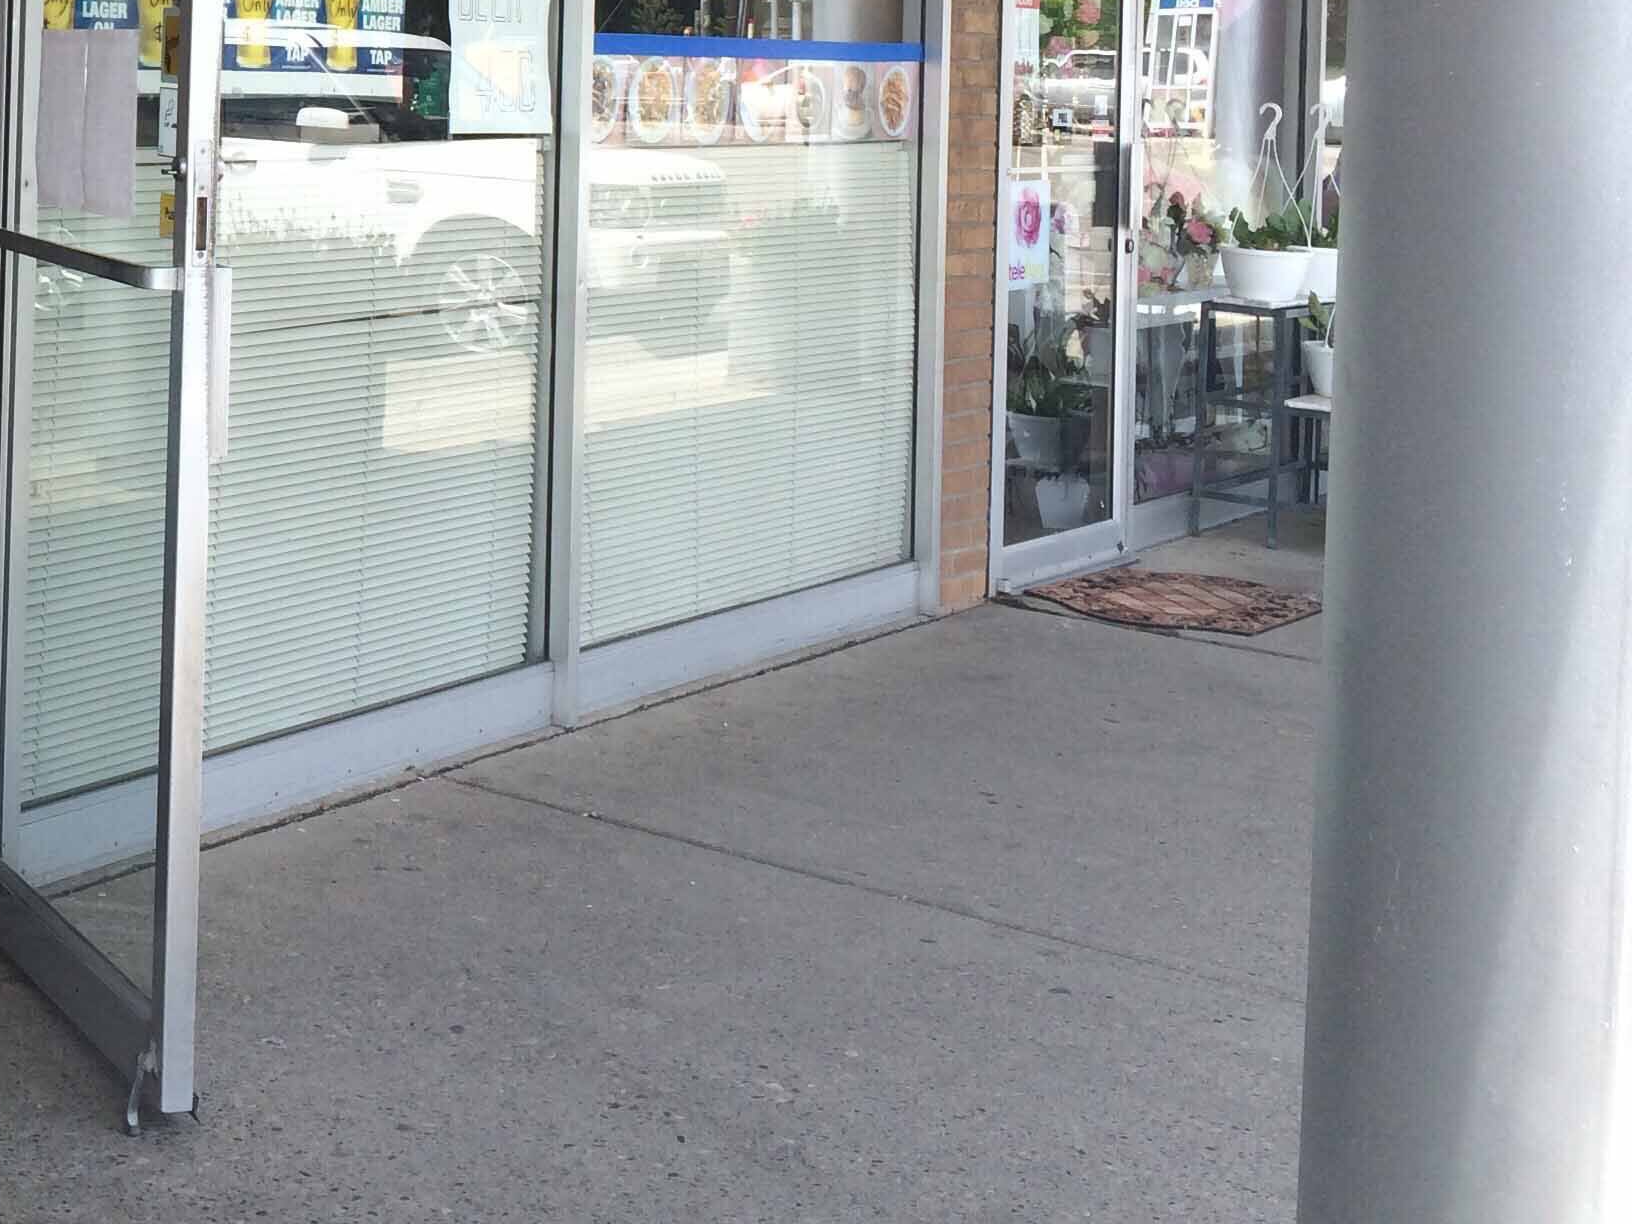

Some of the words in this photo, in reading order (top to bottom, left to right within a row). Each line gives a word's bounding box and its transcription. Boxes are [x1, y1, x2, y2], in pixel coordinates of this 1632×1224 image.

[82, 1, 128, 19] LAGER
[276, 8, 318, 23] LAGER
[362, 14, 401, 31] LAGER
[286, 45, 309, 62] TAP
[370, 49, 392, 65] TAP
